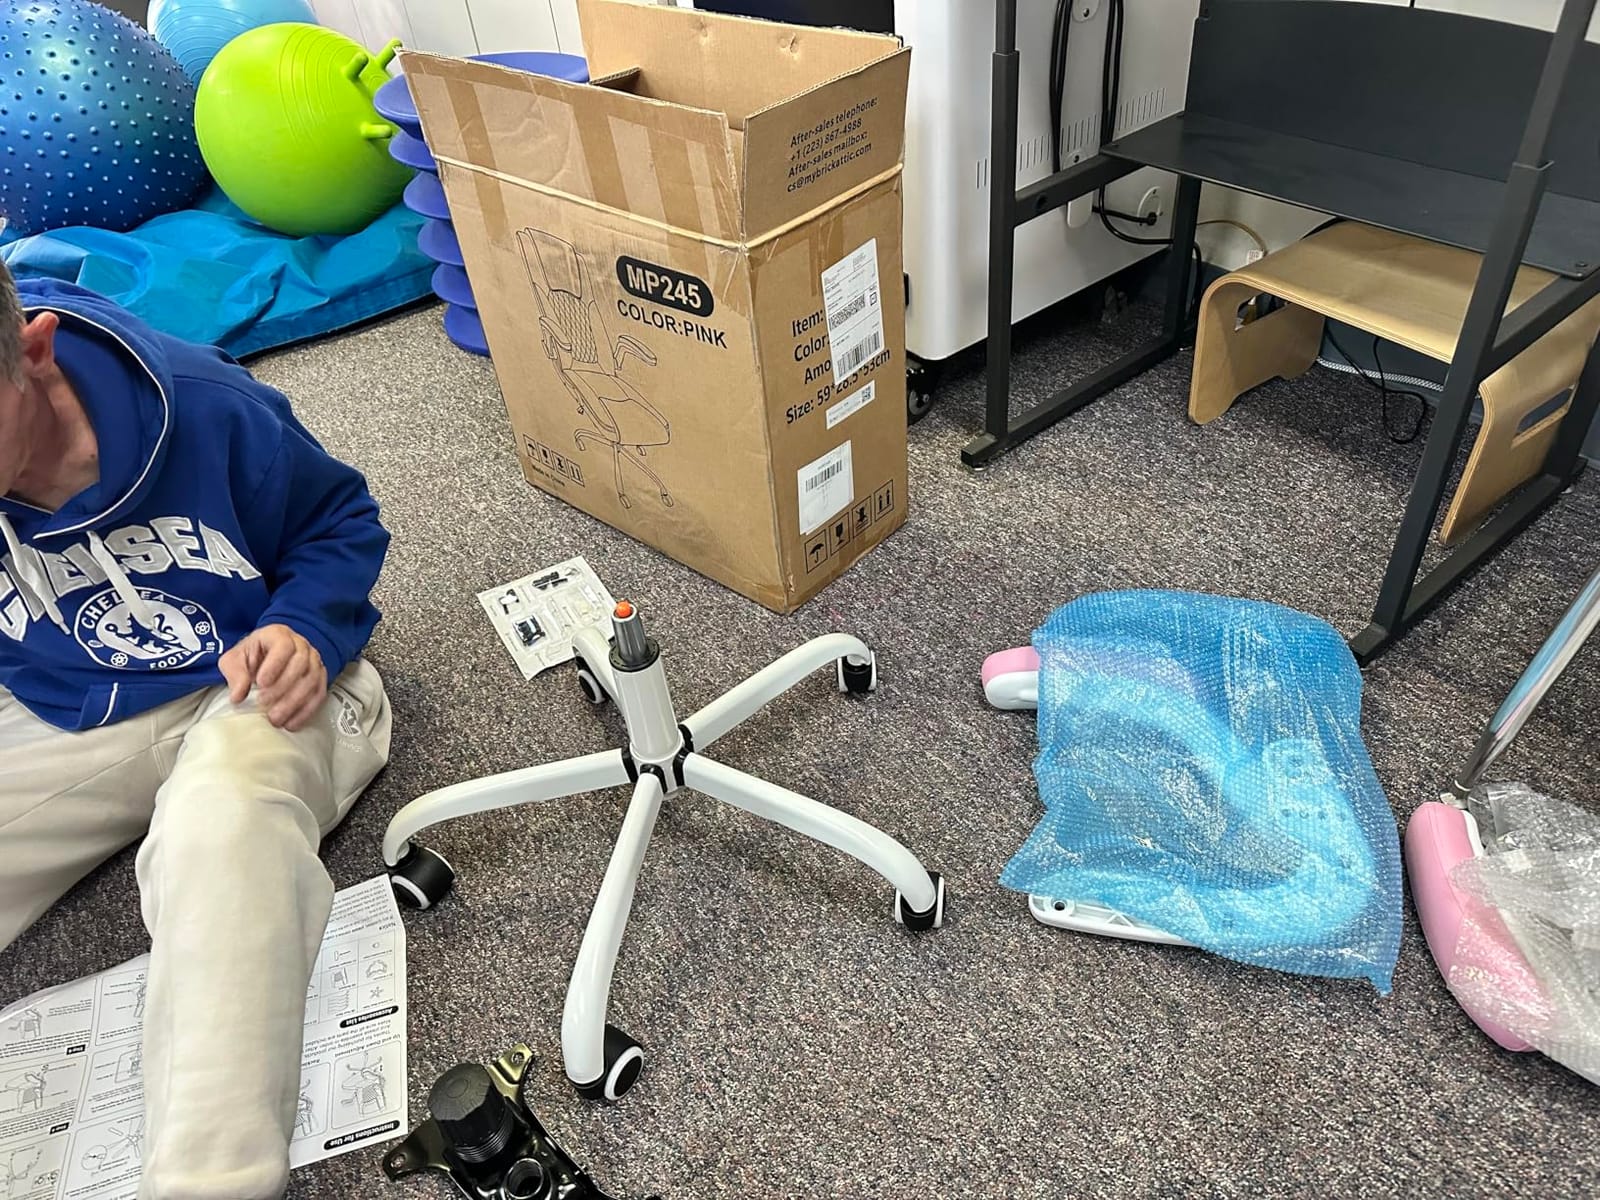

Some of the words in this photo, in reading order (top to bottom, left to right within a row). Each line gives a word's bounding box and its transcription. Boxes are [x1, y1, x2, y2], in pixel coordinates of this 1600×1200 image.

[790, 118, 834, 148] After-sales
[836, 97, 878, 122] telephone:
[788, 148, 832, 178] After-sales
[834, 131, 868, 157] mailbox:
[791, 150, 801, 161] +1
[803, 137, 823, 158] (223)
[787, 143, 872, 192] cs@mybrickattic.com
[626, 263, 702, 309] MP245
[617, 299, 728, 349] COLOR:PINK
[792, 310, 824, 337] Item:
[804, 361, 831, 384] Amo
[786, 399, 815, 424] Size:
[80, 589, 165, 629] CHELEA
[329, 1138, 343, 1147] Use
[343, 1135, 355, 1143] for
[355, 1122, 394, 1139] Instructions
